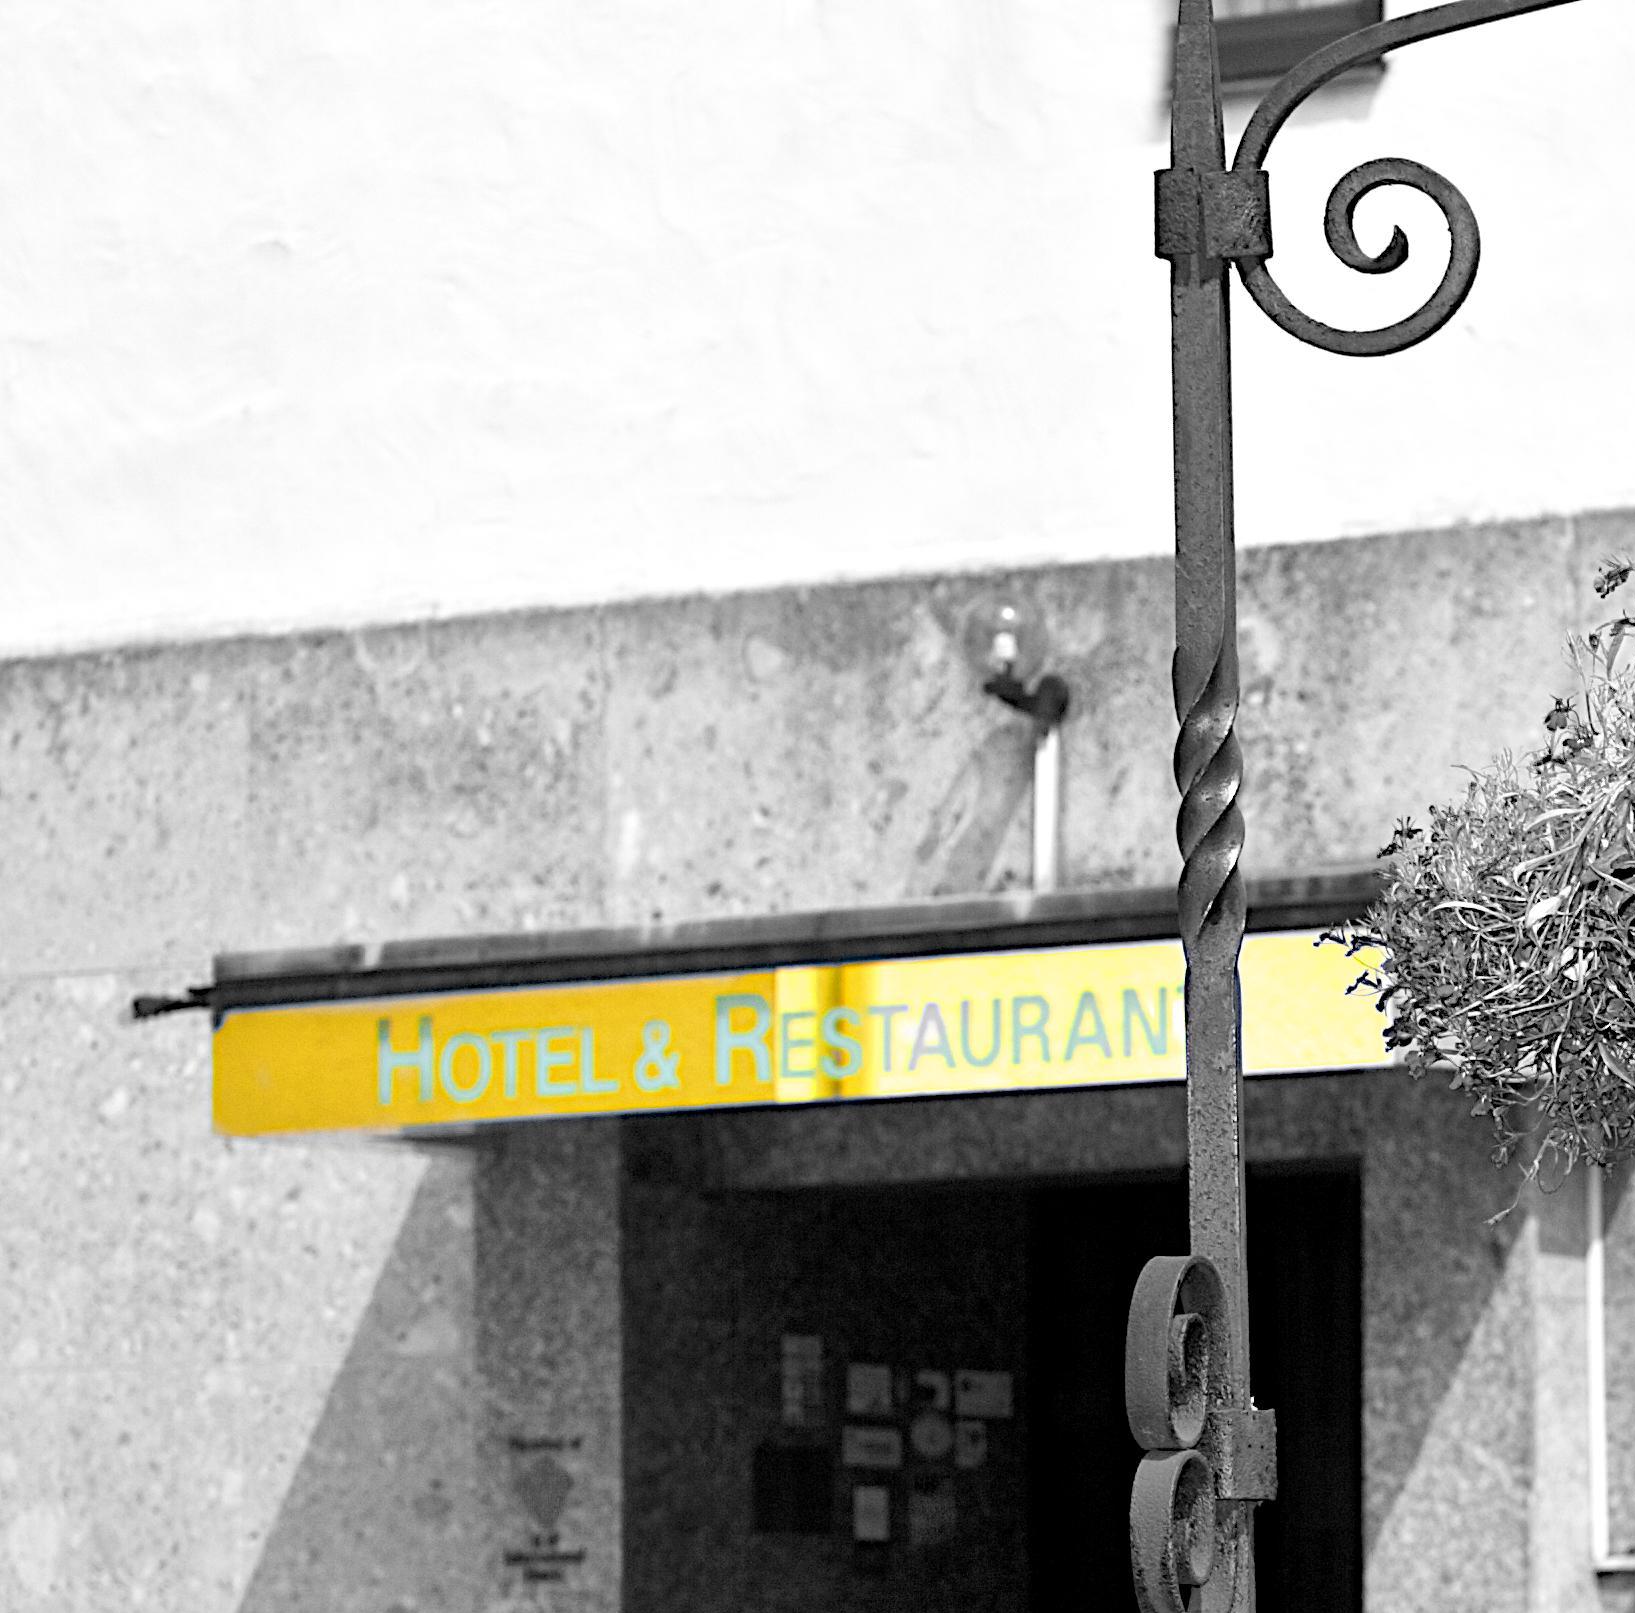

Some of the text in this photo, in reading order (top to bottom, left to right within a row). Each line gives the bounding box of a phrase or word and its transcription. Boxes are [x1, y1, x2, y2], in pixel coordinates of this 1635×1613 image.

[377, 986, 1187, 1105] HOTEL & RESTAURAN
